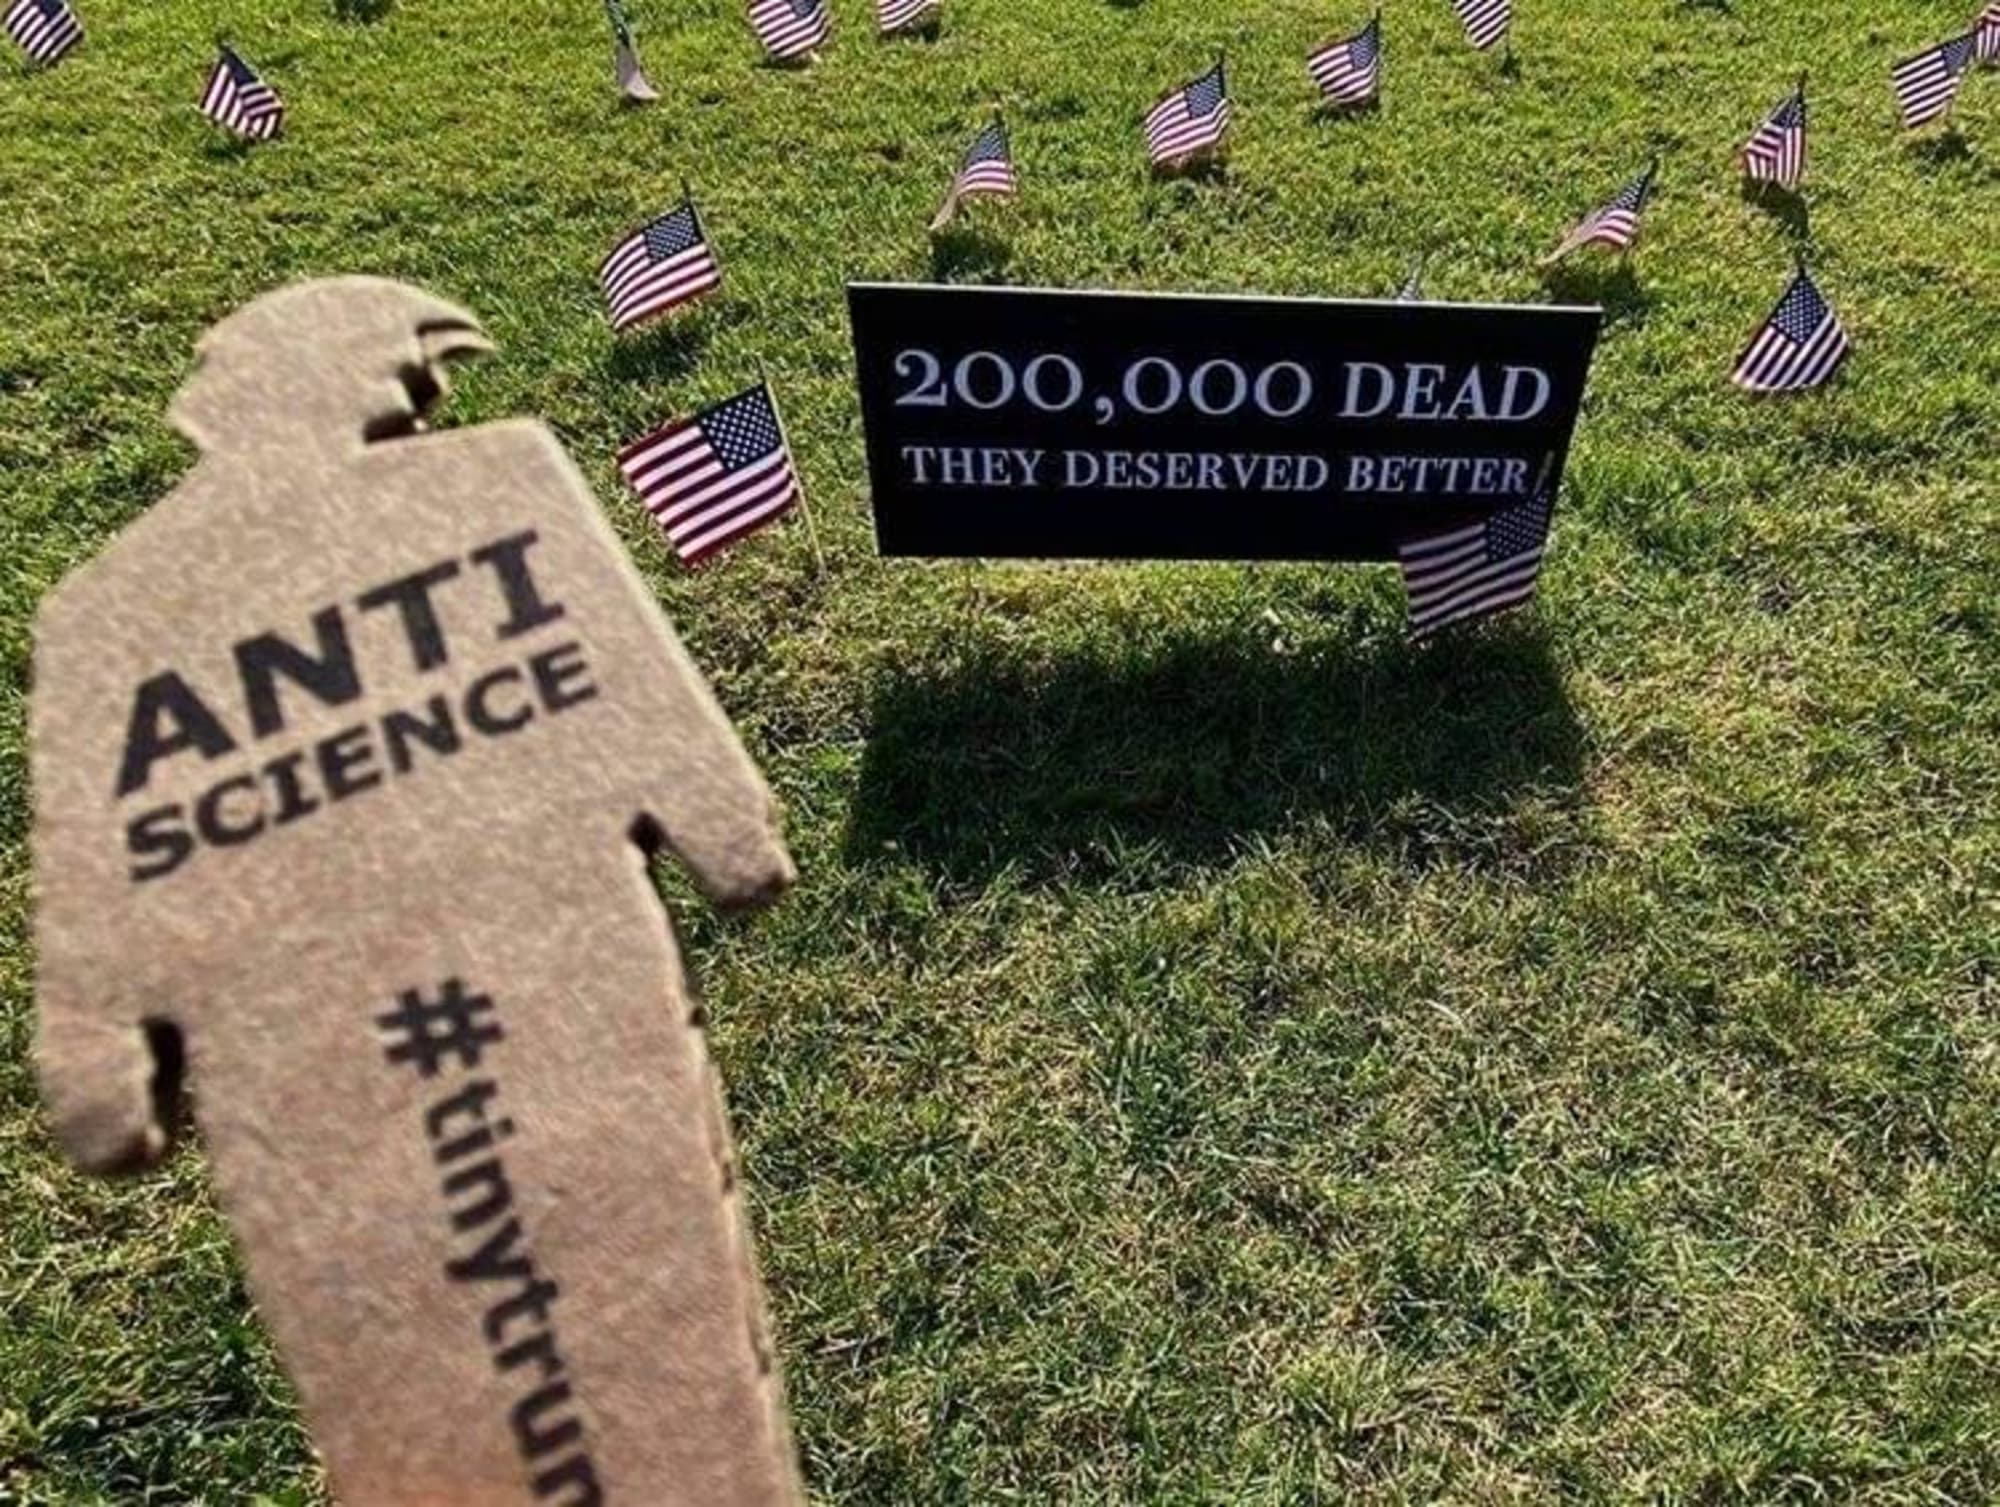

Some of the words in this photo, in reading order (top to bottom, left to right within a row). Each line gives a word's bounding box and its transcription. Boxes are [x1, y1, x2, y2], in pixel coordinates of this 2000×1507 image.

[893, 348, 1313, 425] 200,000
[1337, 361, 1551, 421] DEAD
[901, 445, 1046, 488] THEY
[1063, 449, 1330, 492] DESERVED
[1344, 455, 1529, 494] BETTER
[114, 528, 566, 799] ANTI
[126, 641, 599, 883] SCIENCE
